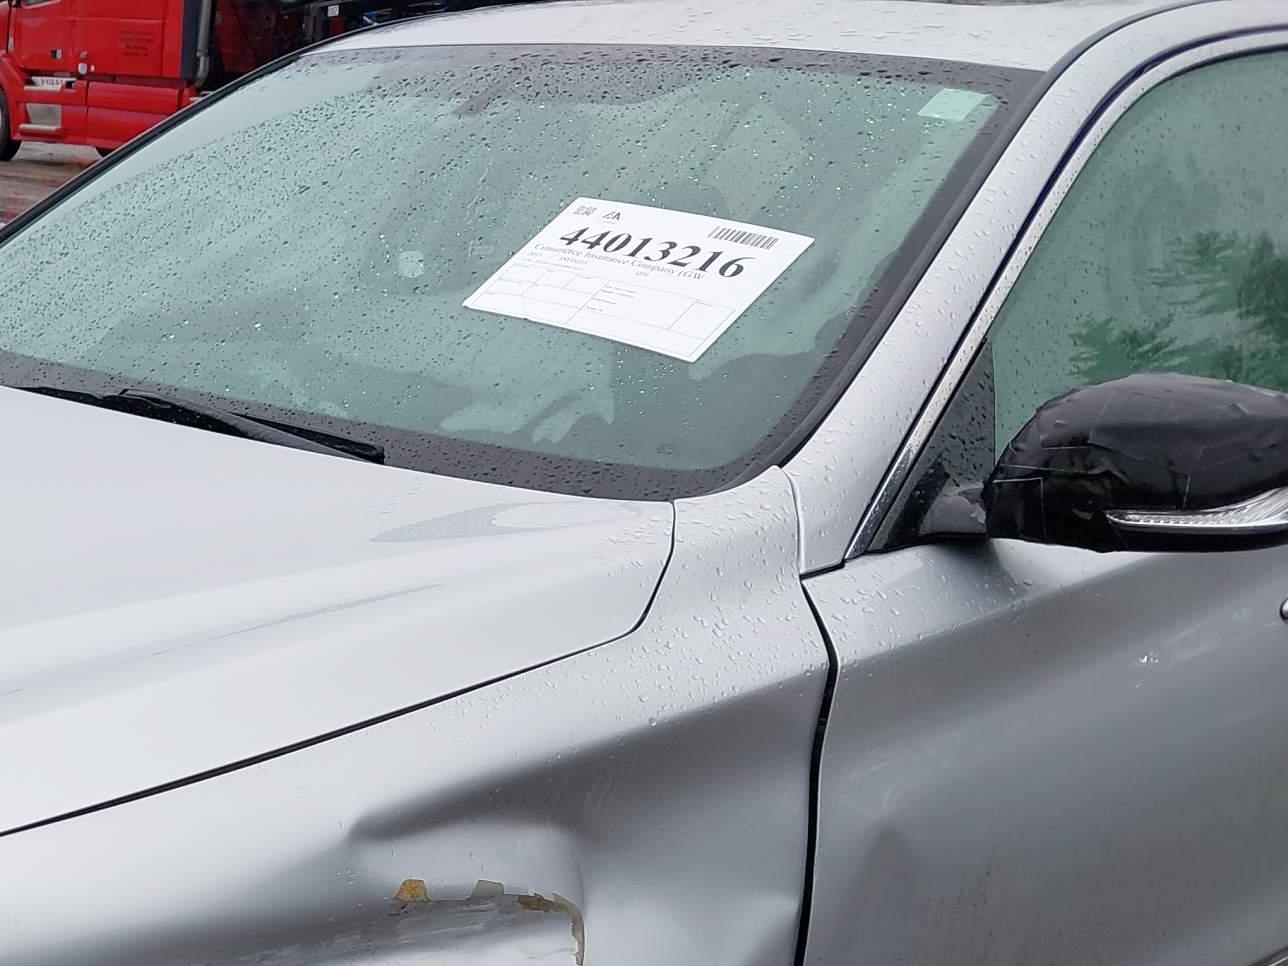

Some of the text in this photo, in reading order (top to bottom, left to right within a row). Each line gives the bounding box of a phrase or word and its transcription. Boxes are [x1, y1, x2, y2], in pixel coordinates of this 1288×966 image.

[559, 226, 756, 278] 44013216
[584, 251, 630, 265] Insurance
[631, 259, 678, 275] Company
